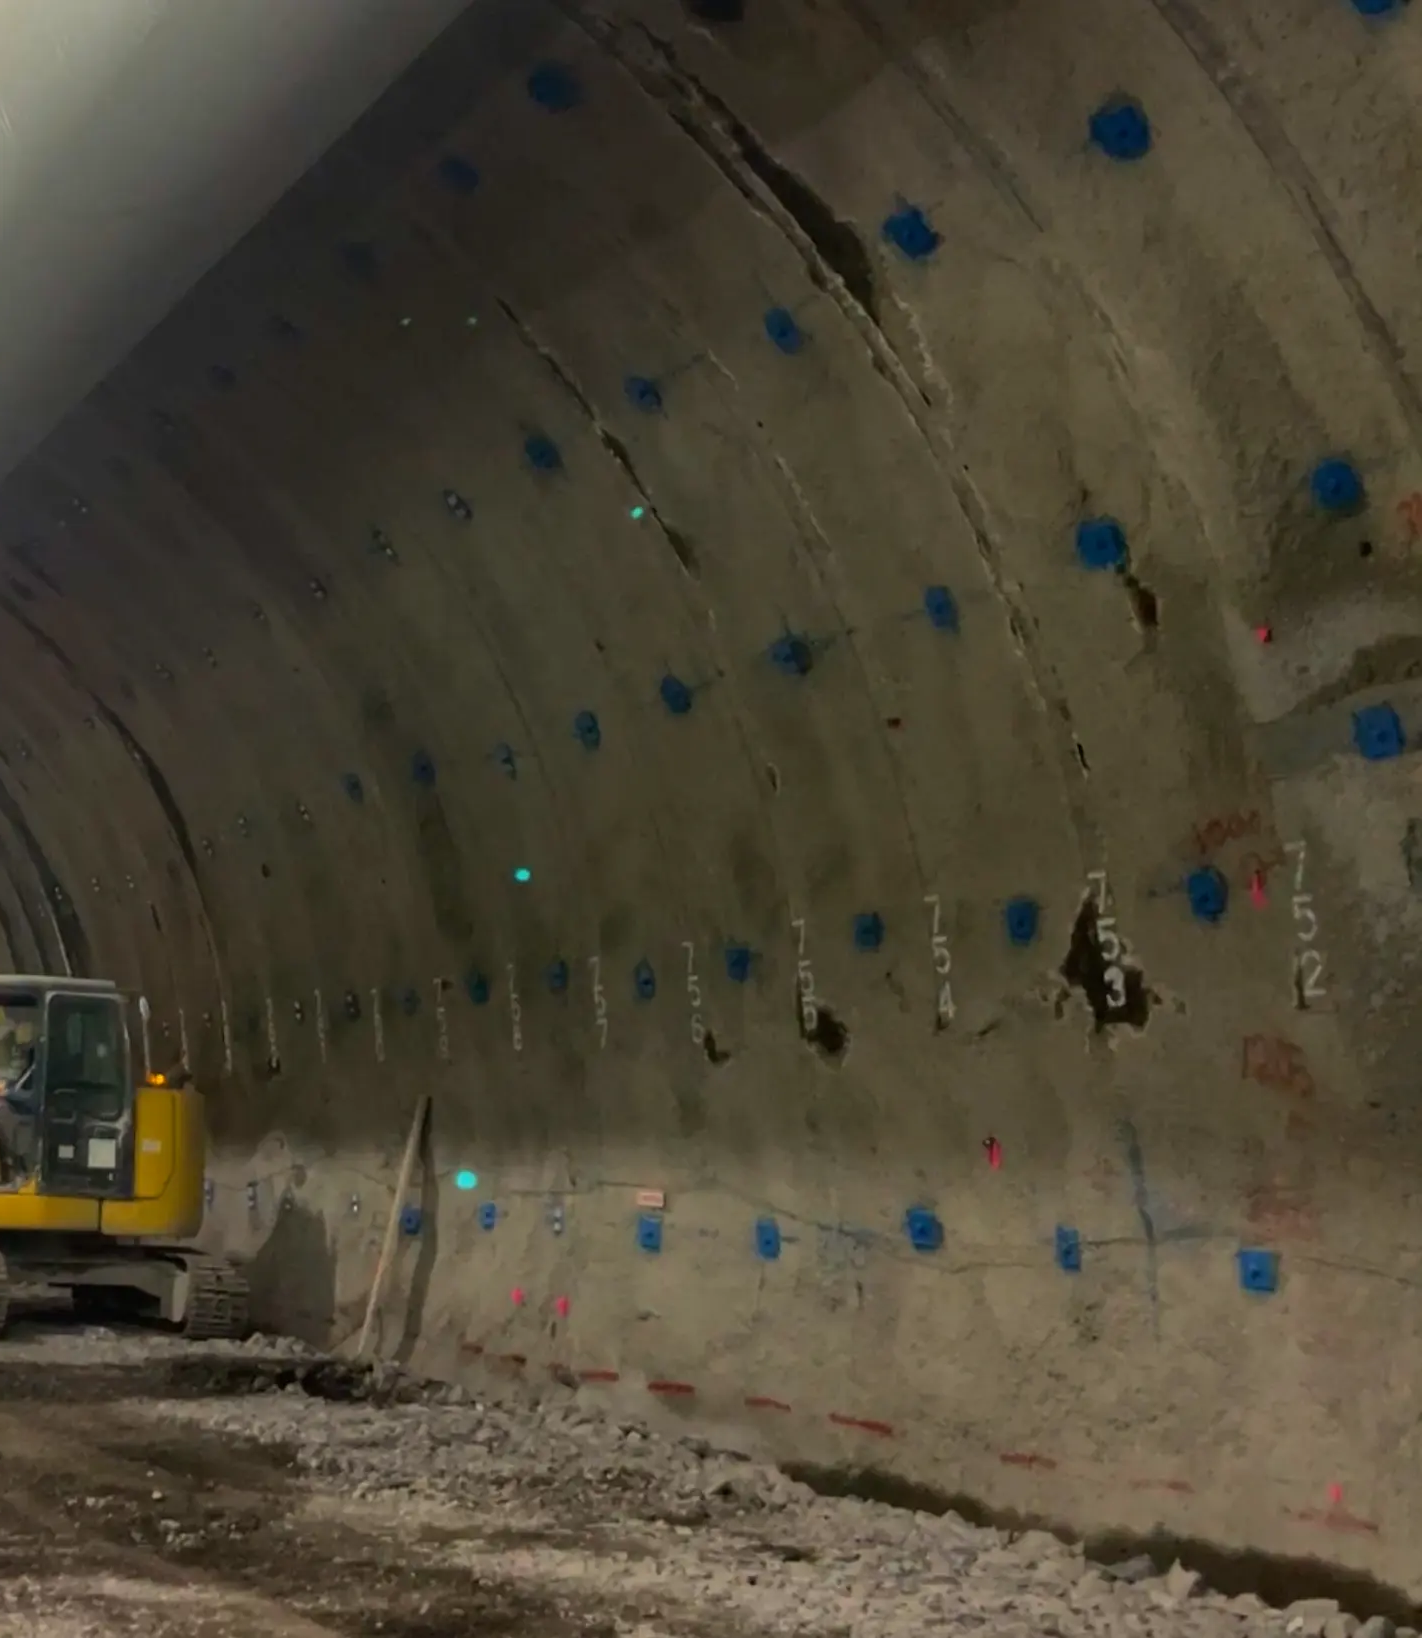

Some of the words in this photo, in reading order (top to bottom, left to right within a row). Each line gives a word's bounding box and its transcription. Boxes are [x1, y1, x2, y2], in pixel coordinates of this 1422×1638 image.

[923, 894, 958, 1020] 754
[1087, 871, 1127, 1008] 753
[1284, 841, 1328, 999] 752
[682, 941, 706, 1043] 756
